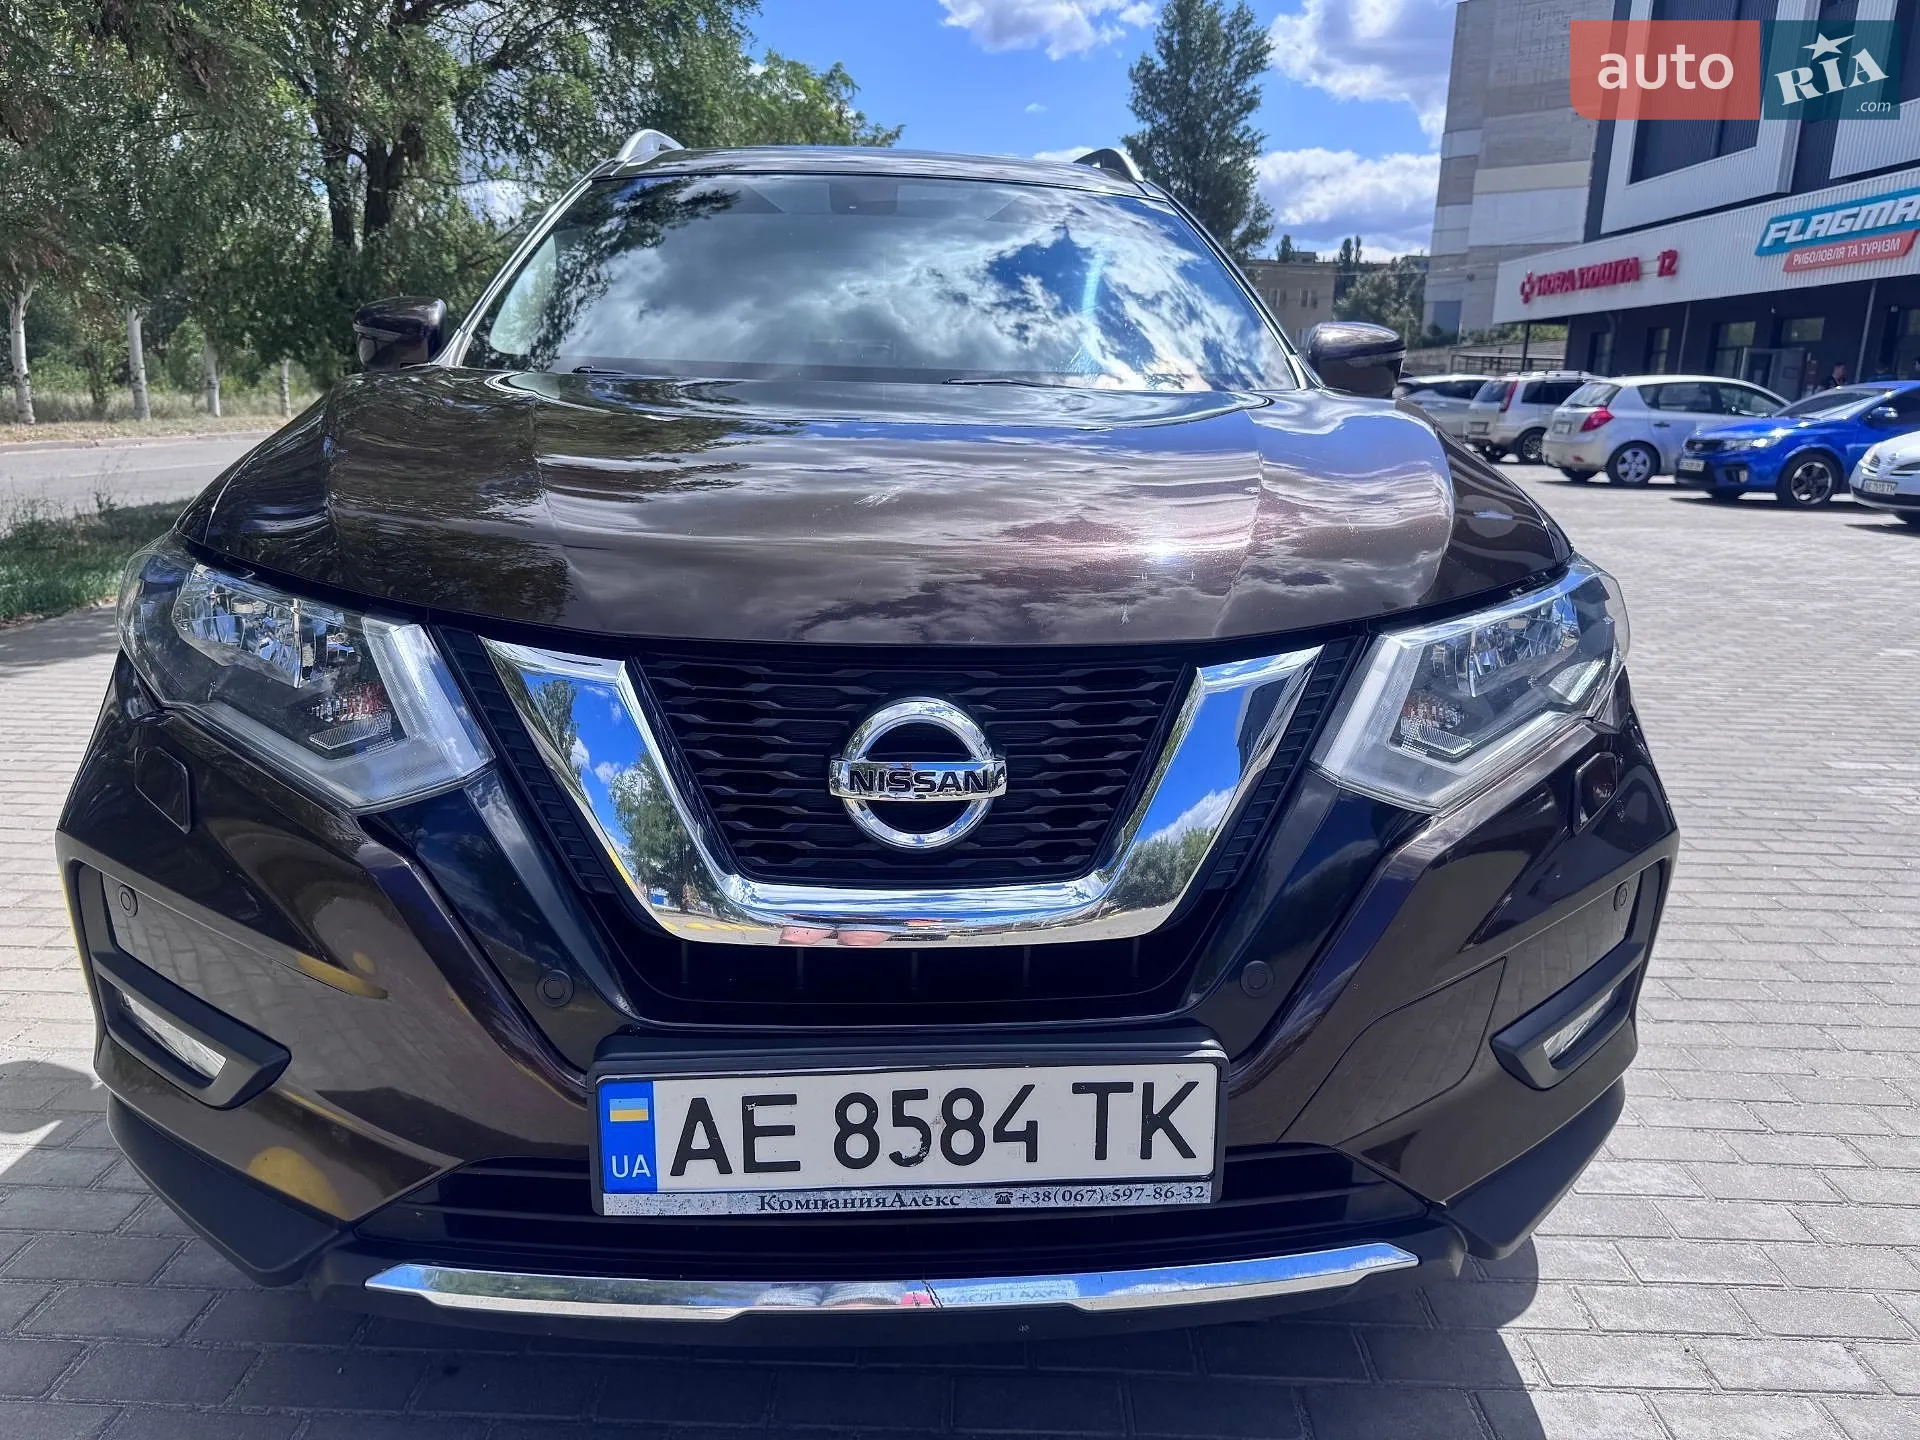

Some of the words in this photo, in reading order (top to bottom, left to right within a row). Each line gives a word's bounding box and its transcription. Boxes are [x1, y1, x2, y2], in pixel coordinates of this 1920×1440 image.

[1657, 249, 1679, 277] 12
[1793, 249, 1846, 266] РИБОЛОВЛЯ
[1847, 245, 1859, 258] ТА
[1861, 238, 1901, 255] ТУРИЗМ
[849, 769, 988, 793] NISSAN
[669, 1093, 802, 1177] AE
[832, 1083, 1039, 1170] 8584
[1071, 1080, 1200, 1161] TK
[611, 1155, 651, 1179] UA
